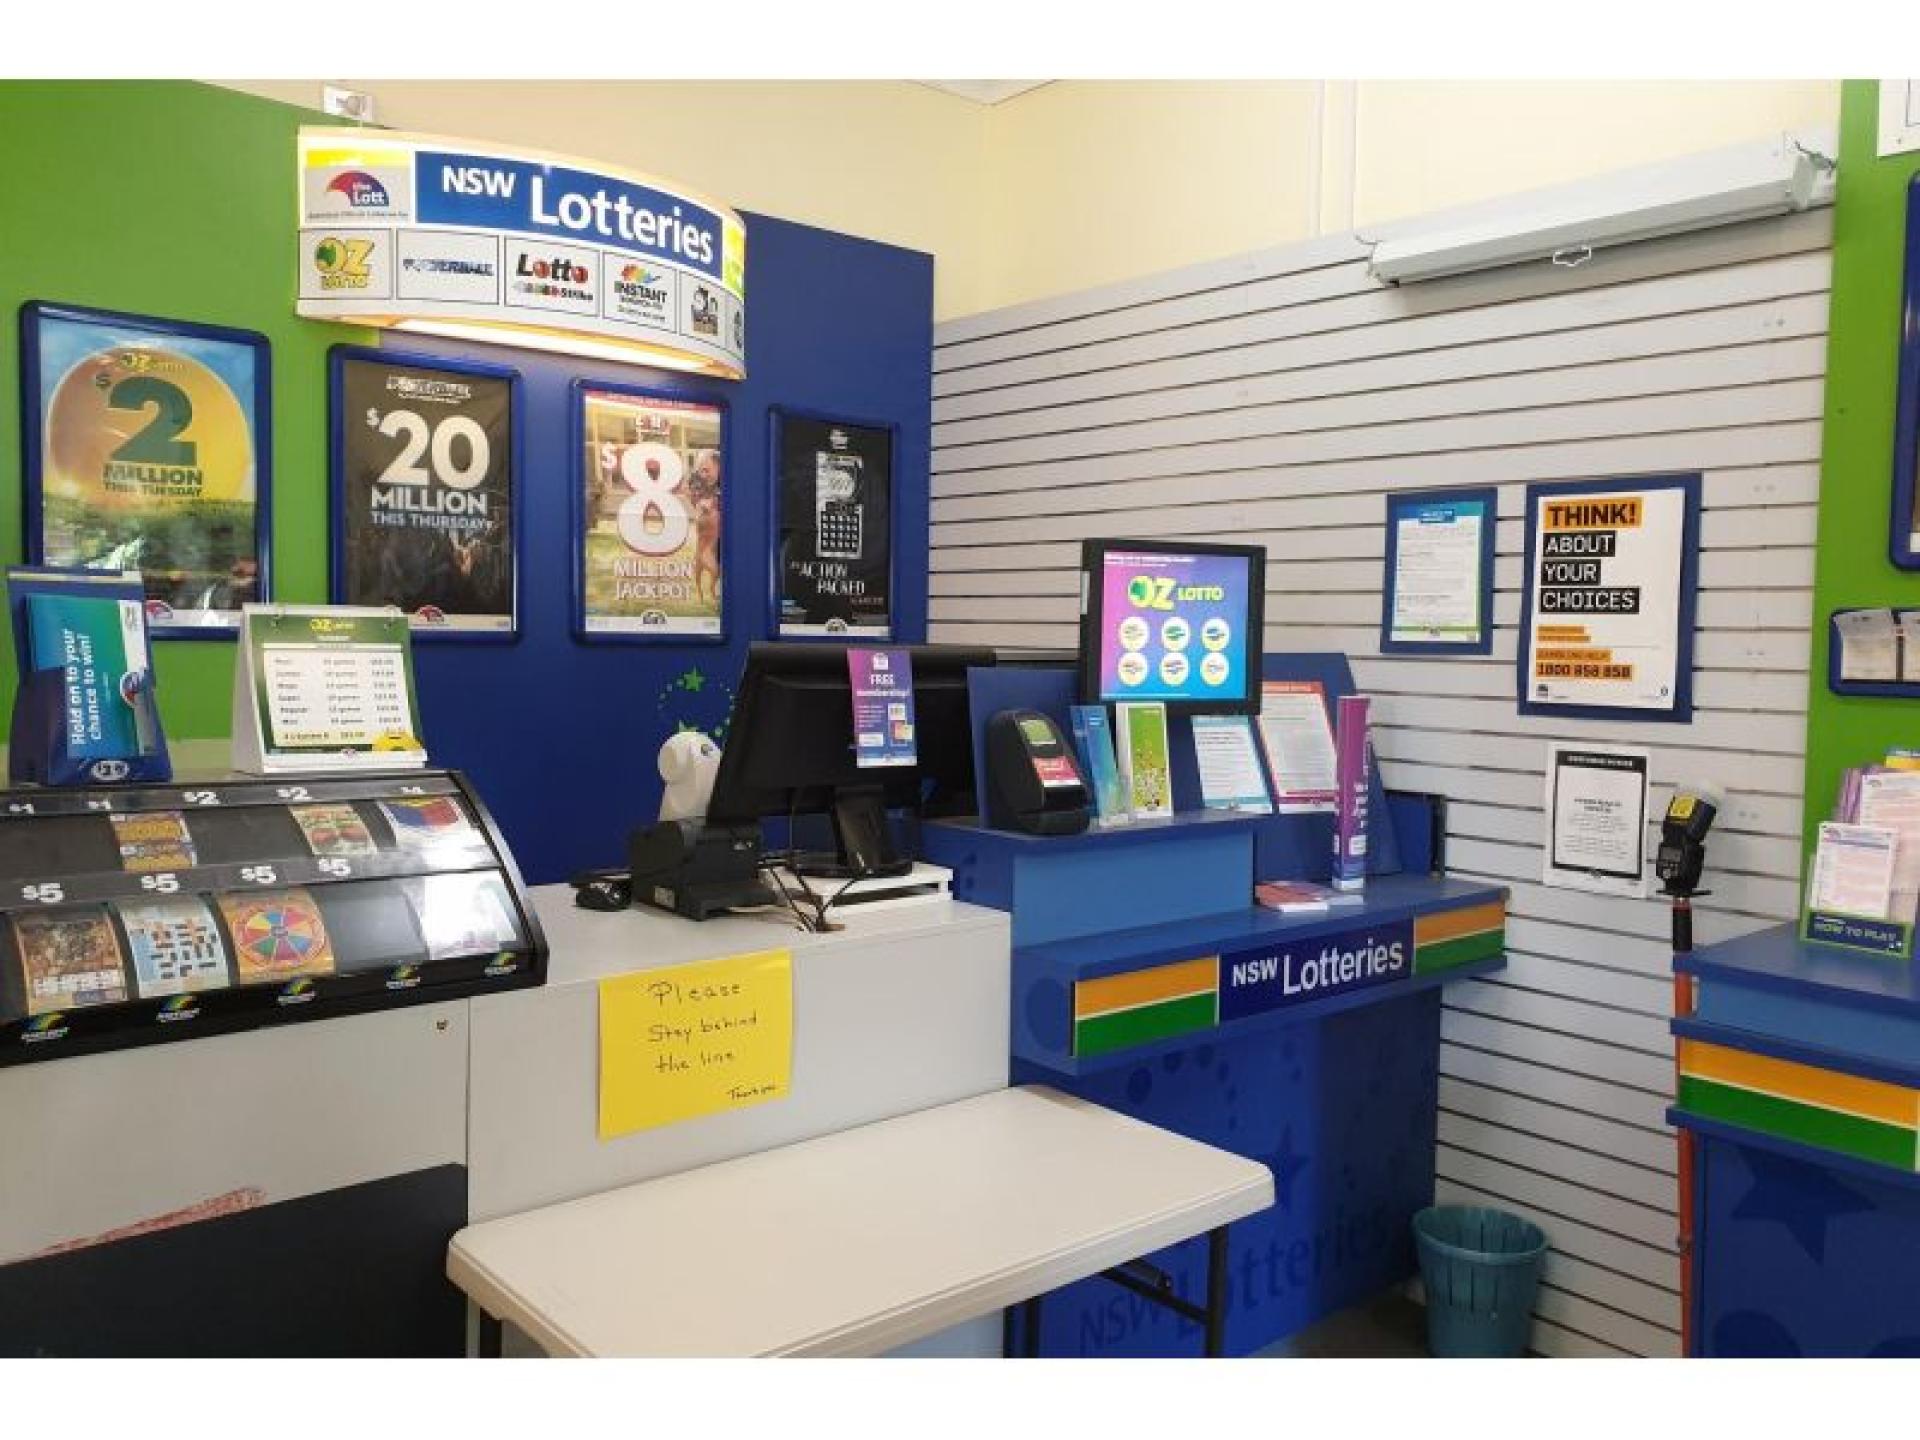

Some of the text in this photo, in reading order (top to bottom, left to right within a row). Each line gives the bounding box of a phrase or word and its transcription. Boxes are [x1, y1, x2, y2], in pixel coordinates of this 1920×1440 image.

[353, 190, 386, 206] Lott
[442, 165, 715, 265] NSW Lotteries
[314, 237, 375, 276] OZ
[516, 254, 589, 284] Lotto
[366, 406, 491, 491] $20
[103, 462, 204, 486] MILLION
[370, 485, 488, 515] MILLION
[370, 511, 405, 526] THIS
[1548, 503, 1636, 527] THINK!
[1545, 534, 1614, 554] ABOUT
[614, 558, 694, 579] MILLION
[1544, 563, 1598, 583] YOUR
[616, 581, 691, 602] JACKPOT
[816, 580, 866, 596] PACKED
[1128, 575, 1225, 611] OZ LOTTO
[1542, 592, 1636, 609] CHOICES
[1537, 663, 1570, 676] 1800
[63, 628, 85, 744] Hold on to your
[76, 632, 101, 740] chance to win!
[239, 865, 278, 885] $5
[318, 858, 351, 877] $5
[21, 882, 64, 904] $5
[141, 873, 180, 893] $5
[1232, 937, 1403, 996] NSW Lotteries
[648, 980, 741, 1007] Please
[700, 1008, 757, 1033] behind
[655, 1051, 735, 1074] the line
